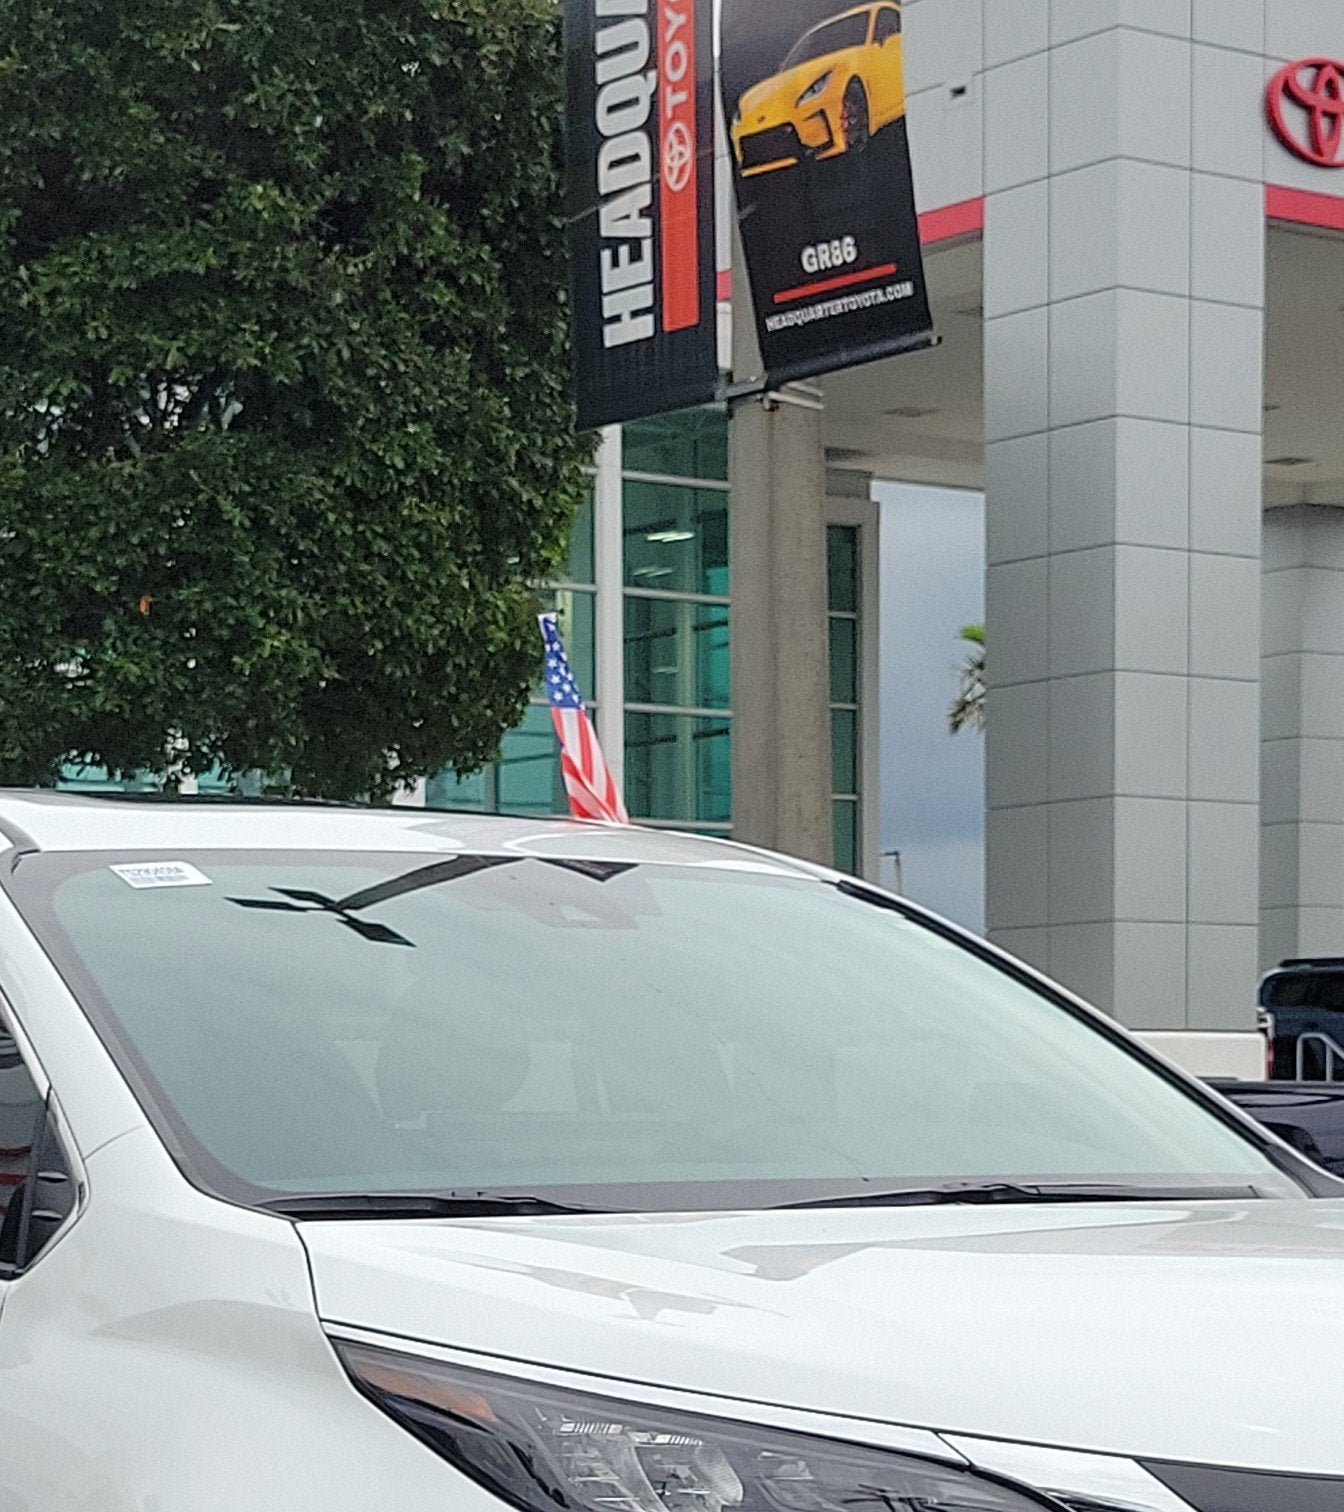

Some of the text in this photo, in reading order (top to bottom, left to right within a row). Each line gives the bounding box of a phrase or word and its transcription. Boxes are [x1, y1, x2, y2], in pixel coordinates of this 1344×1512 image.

[664, 0, 689, 119] TOY
[594, 0, 657, 348] HEADQU
[800, 235, 857, 273] GR86
